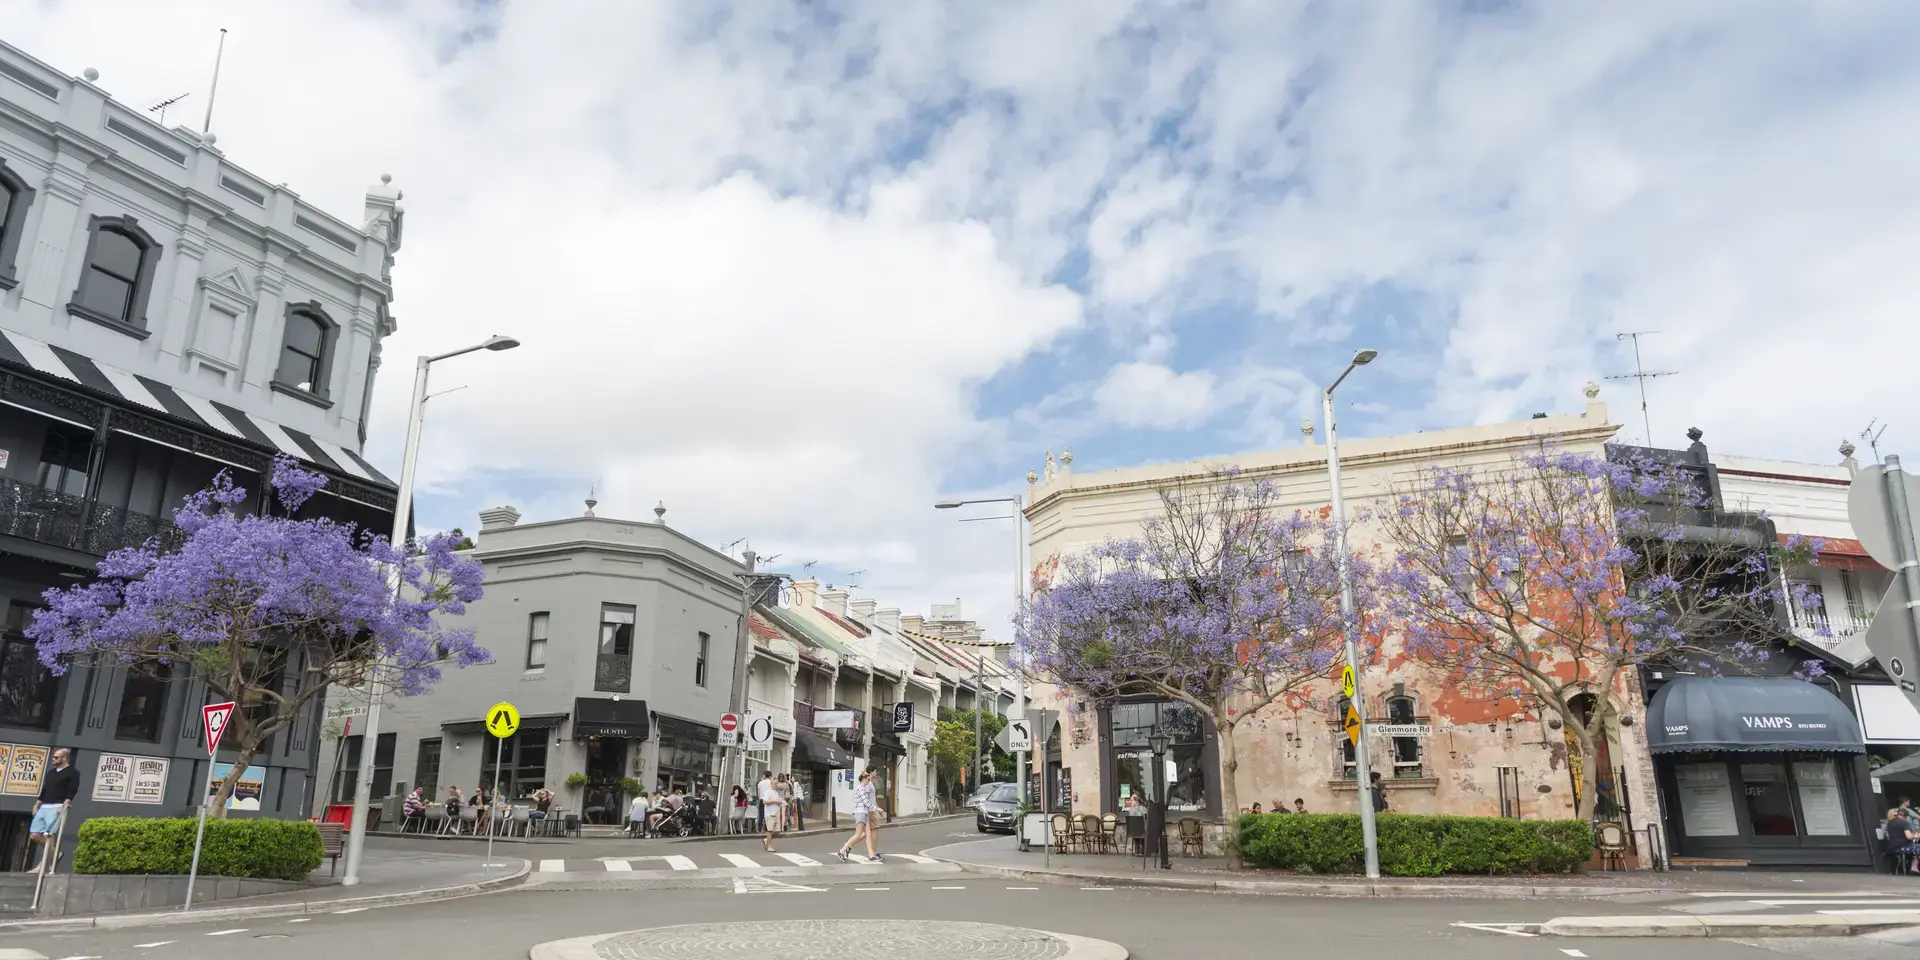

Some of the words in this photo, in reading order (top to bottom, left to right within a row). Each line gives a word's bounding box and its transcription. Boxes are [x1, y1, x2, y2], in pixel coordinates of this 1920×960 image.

[327, 709, 354, 718] Brougton
[1742, 716, 1793, 729] VAMPS
[1378, 725, 1417, 733] Glenmore
[1419, 725, 1430, 733] Rd
[106, 756, 125, 766] LUNCH
[139, 760, 164, 772] TUESDAYS
[100, 764, 127, 774] SPECIALS
[11, 771, 37, 782] STEAK
